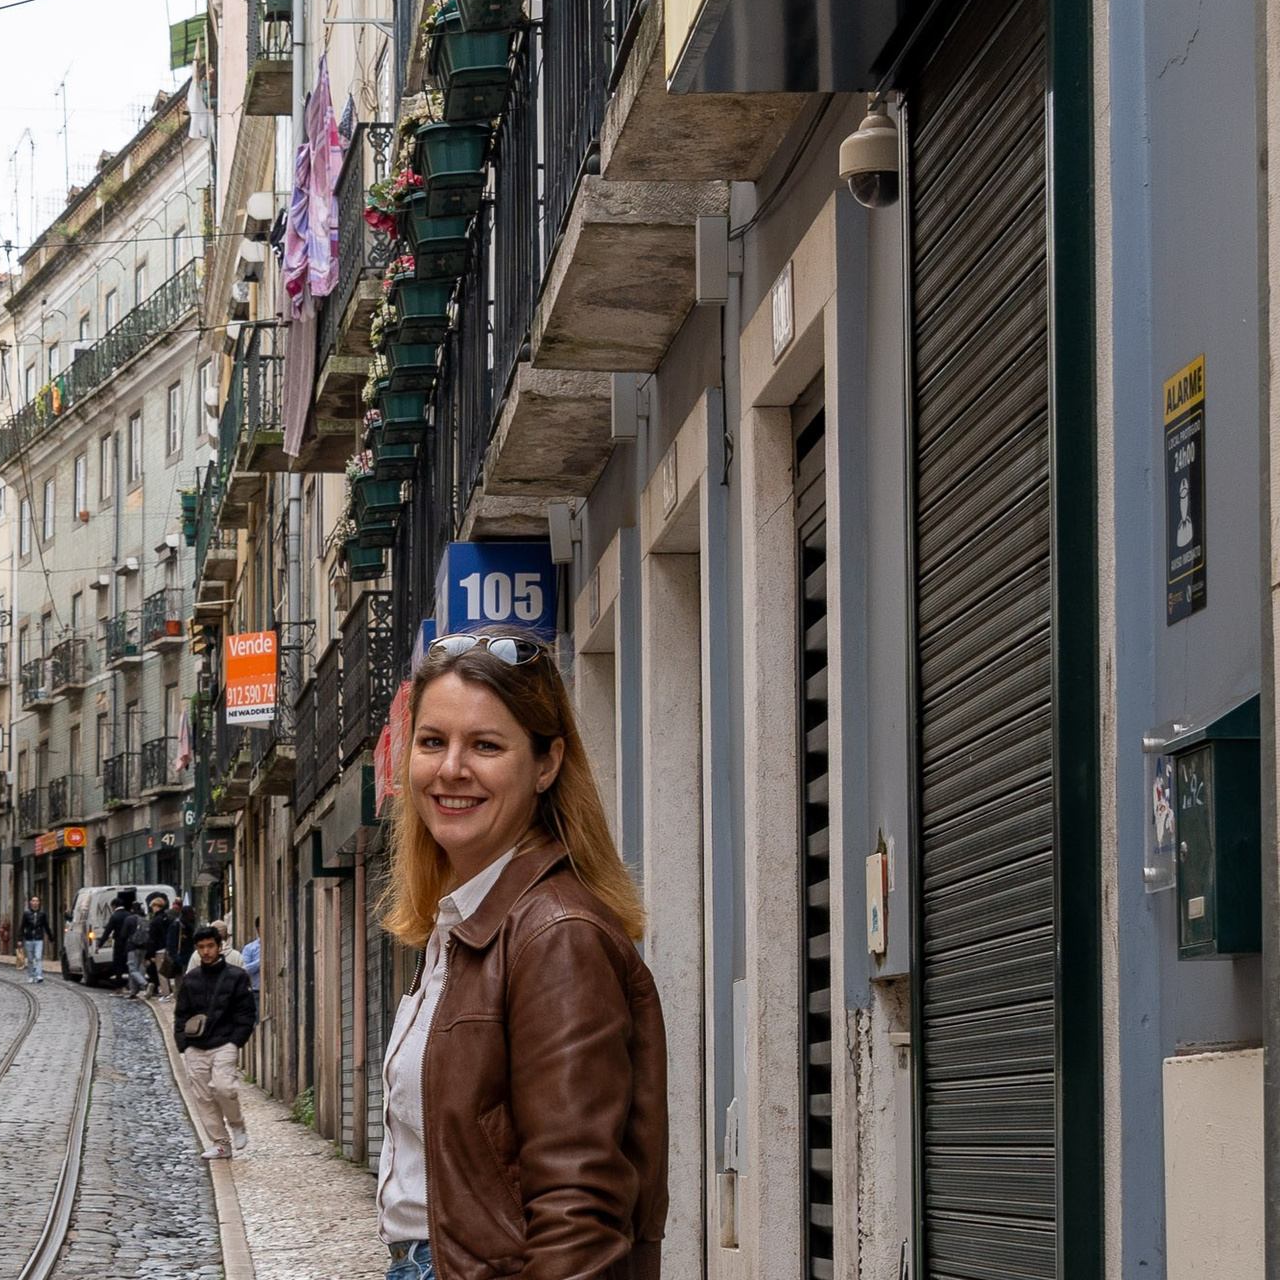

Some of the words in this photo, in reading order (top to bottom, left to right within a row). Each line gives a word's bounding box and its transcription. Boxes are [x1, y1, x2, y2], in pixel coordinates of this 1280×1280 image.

[1166, 365, 1202, 416] ALARME
[1174, 441, 1195, 473] 24h00
[460, 573, 544, 621] 105
[228, 632, 272, 657] Vende
[227, 686, 243, 706] 912
[244, 684, 261, 705] 590
[262, 683, 276, 703] 74
[161, 833, 175, 846] 47
[205, 839, 228, 853] 75
